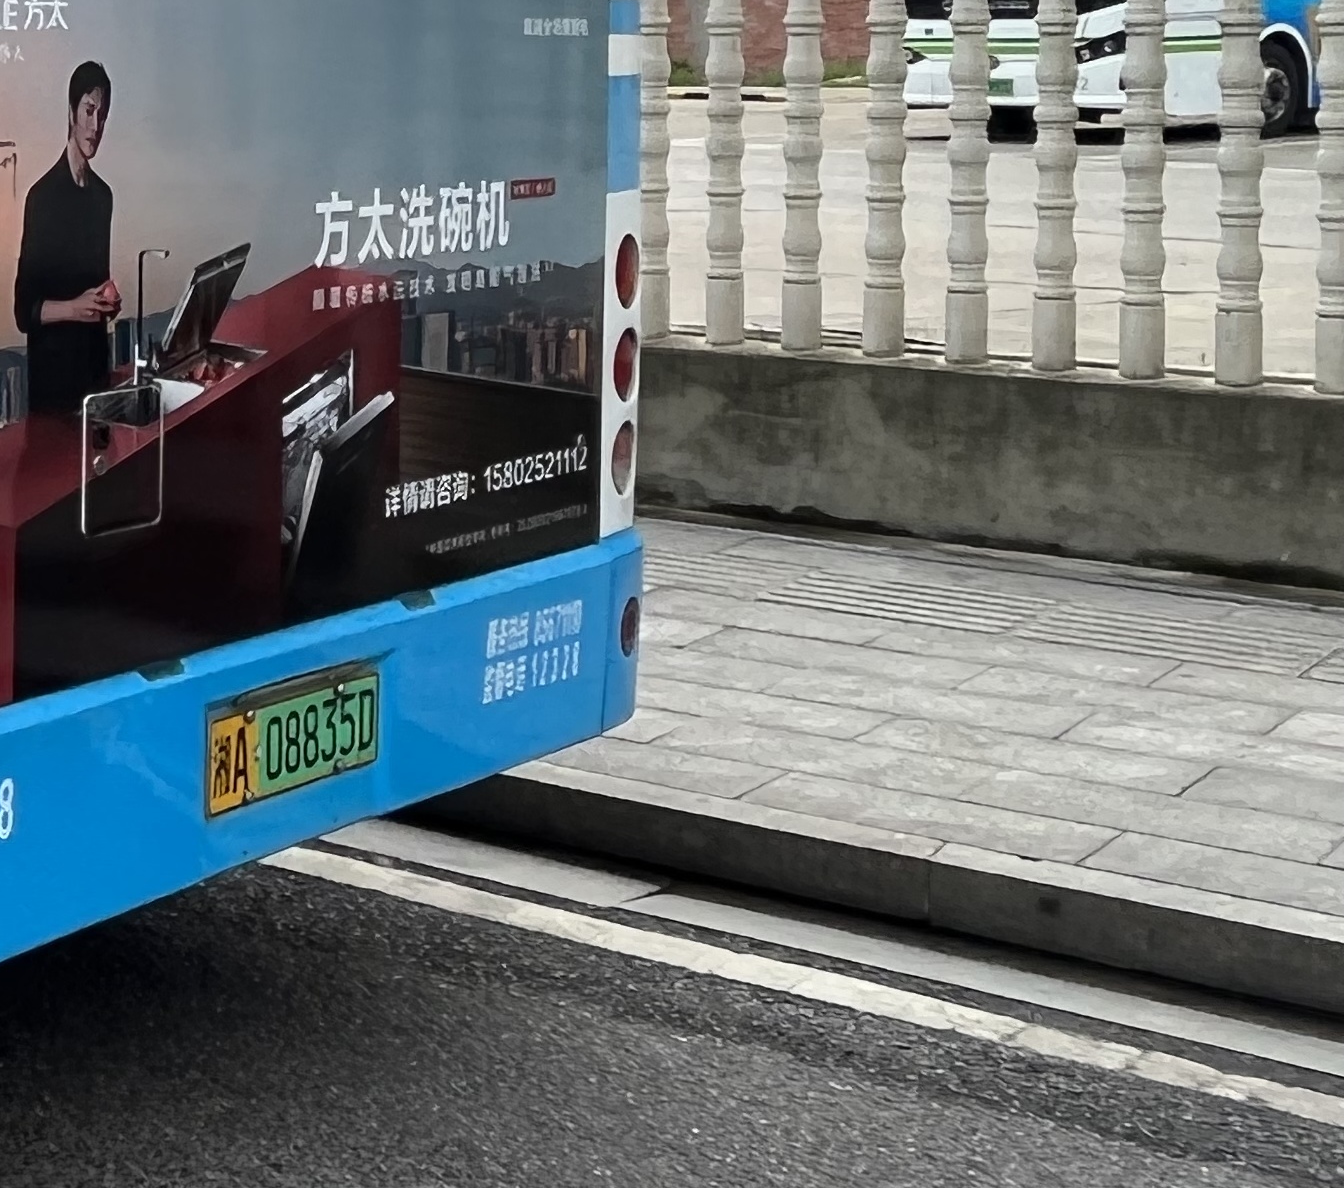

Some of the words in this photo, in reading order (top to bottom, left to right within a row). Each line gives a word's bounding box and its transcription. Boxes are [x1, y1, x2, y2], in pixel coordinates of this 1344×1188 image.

[314, 179, 511, 269] 方太洗碗机
[483, 445, 589, 493] 15802521112
